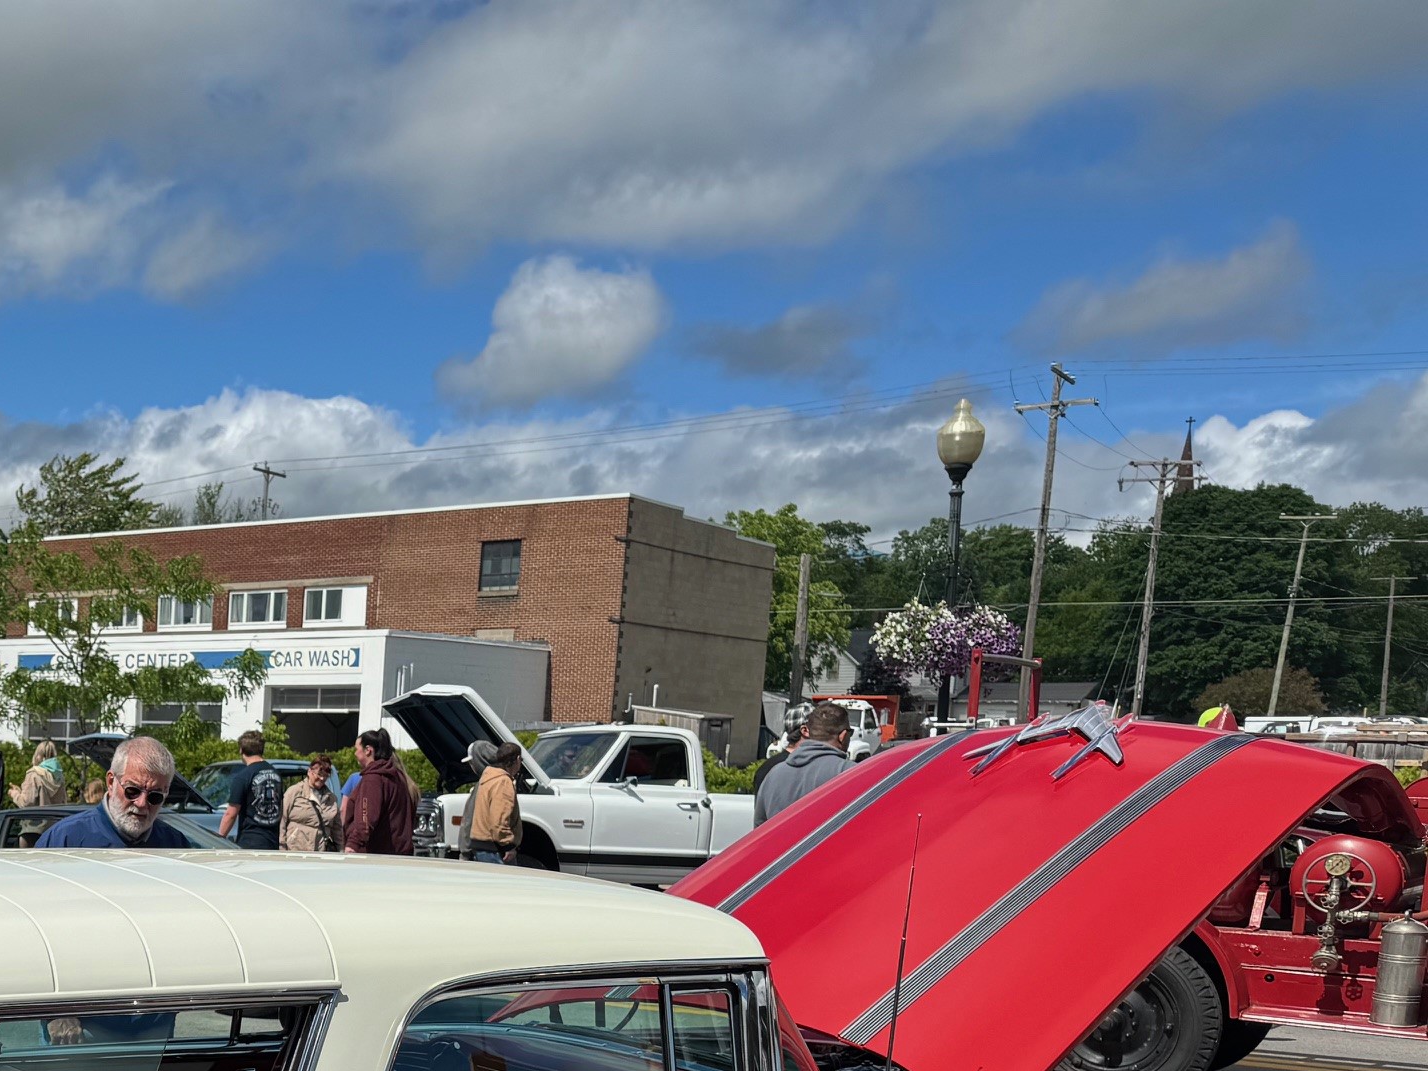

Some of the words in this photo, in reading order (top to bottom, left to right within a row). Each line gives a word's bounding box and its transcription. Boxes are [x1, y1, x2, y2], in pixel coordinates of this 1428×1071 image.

[125, 653, 189, 669] CENTER
[274, 651, 303, 667] CAR
[309, 650, 350, 666] WASH
